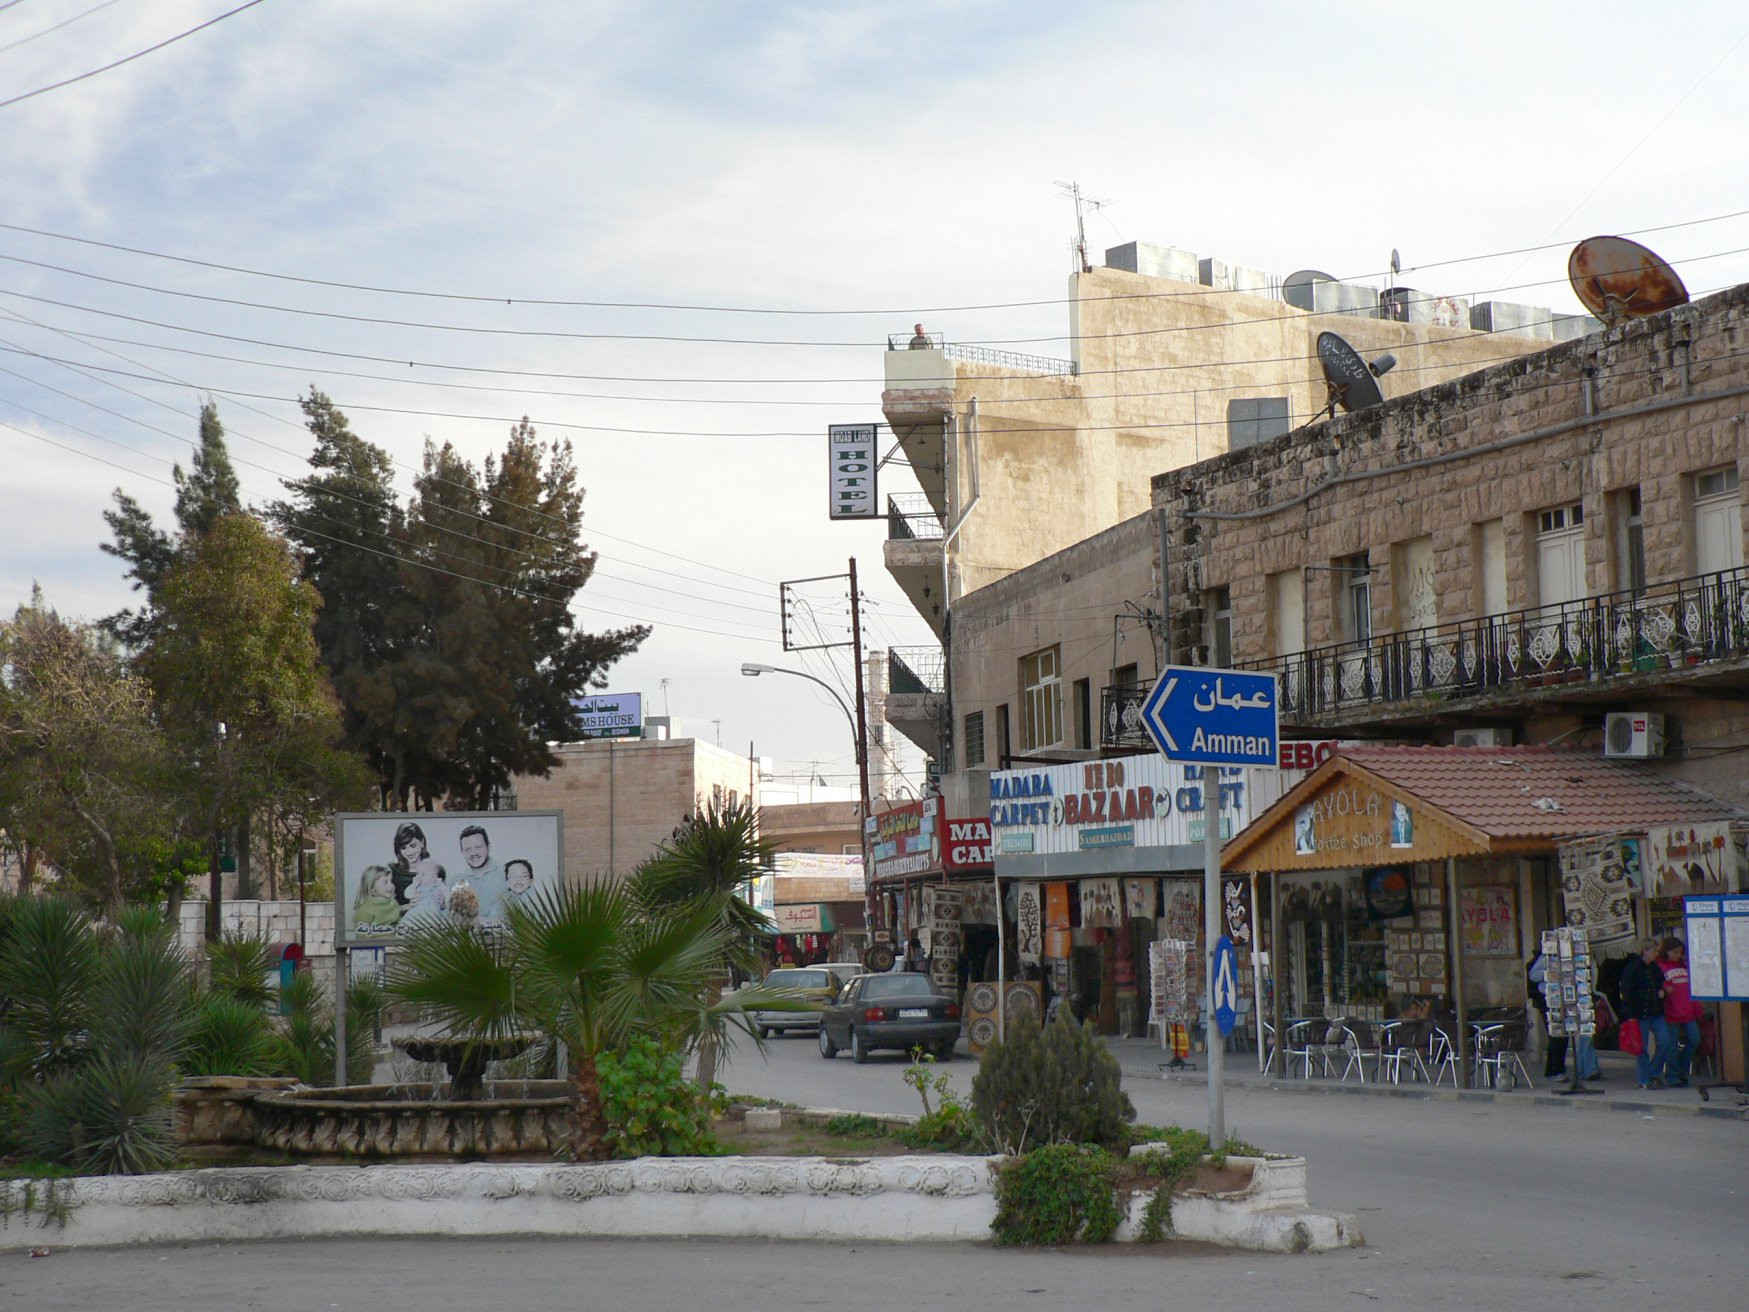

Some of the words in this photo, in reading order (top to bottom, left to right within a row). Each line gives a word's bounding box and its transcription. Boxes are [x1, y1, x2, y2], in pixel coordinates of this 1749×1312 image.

[837, 450, 868, 514] HOTEL
[1193, 677, 1271, 712] عمان
[598, 714, 634, 727] HOUSE
[1191, 726, 1270, 757] Amman
[1279, 742, 1333, 769] EBO
[989, 773, 1053, 801] MADABA
[1083, 761, 1125, 790] NEBO
[1064, 785, 1154, 825] BAZAAR
[1176, 781, 1243, 813] CRFT
[1313, 790, 1379, 822] AYOLA
[990, 801, 1051, 827] CARPET
